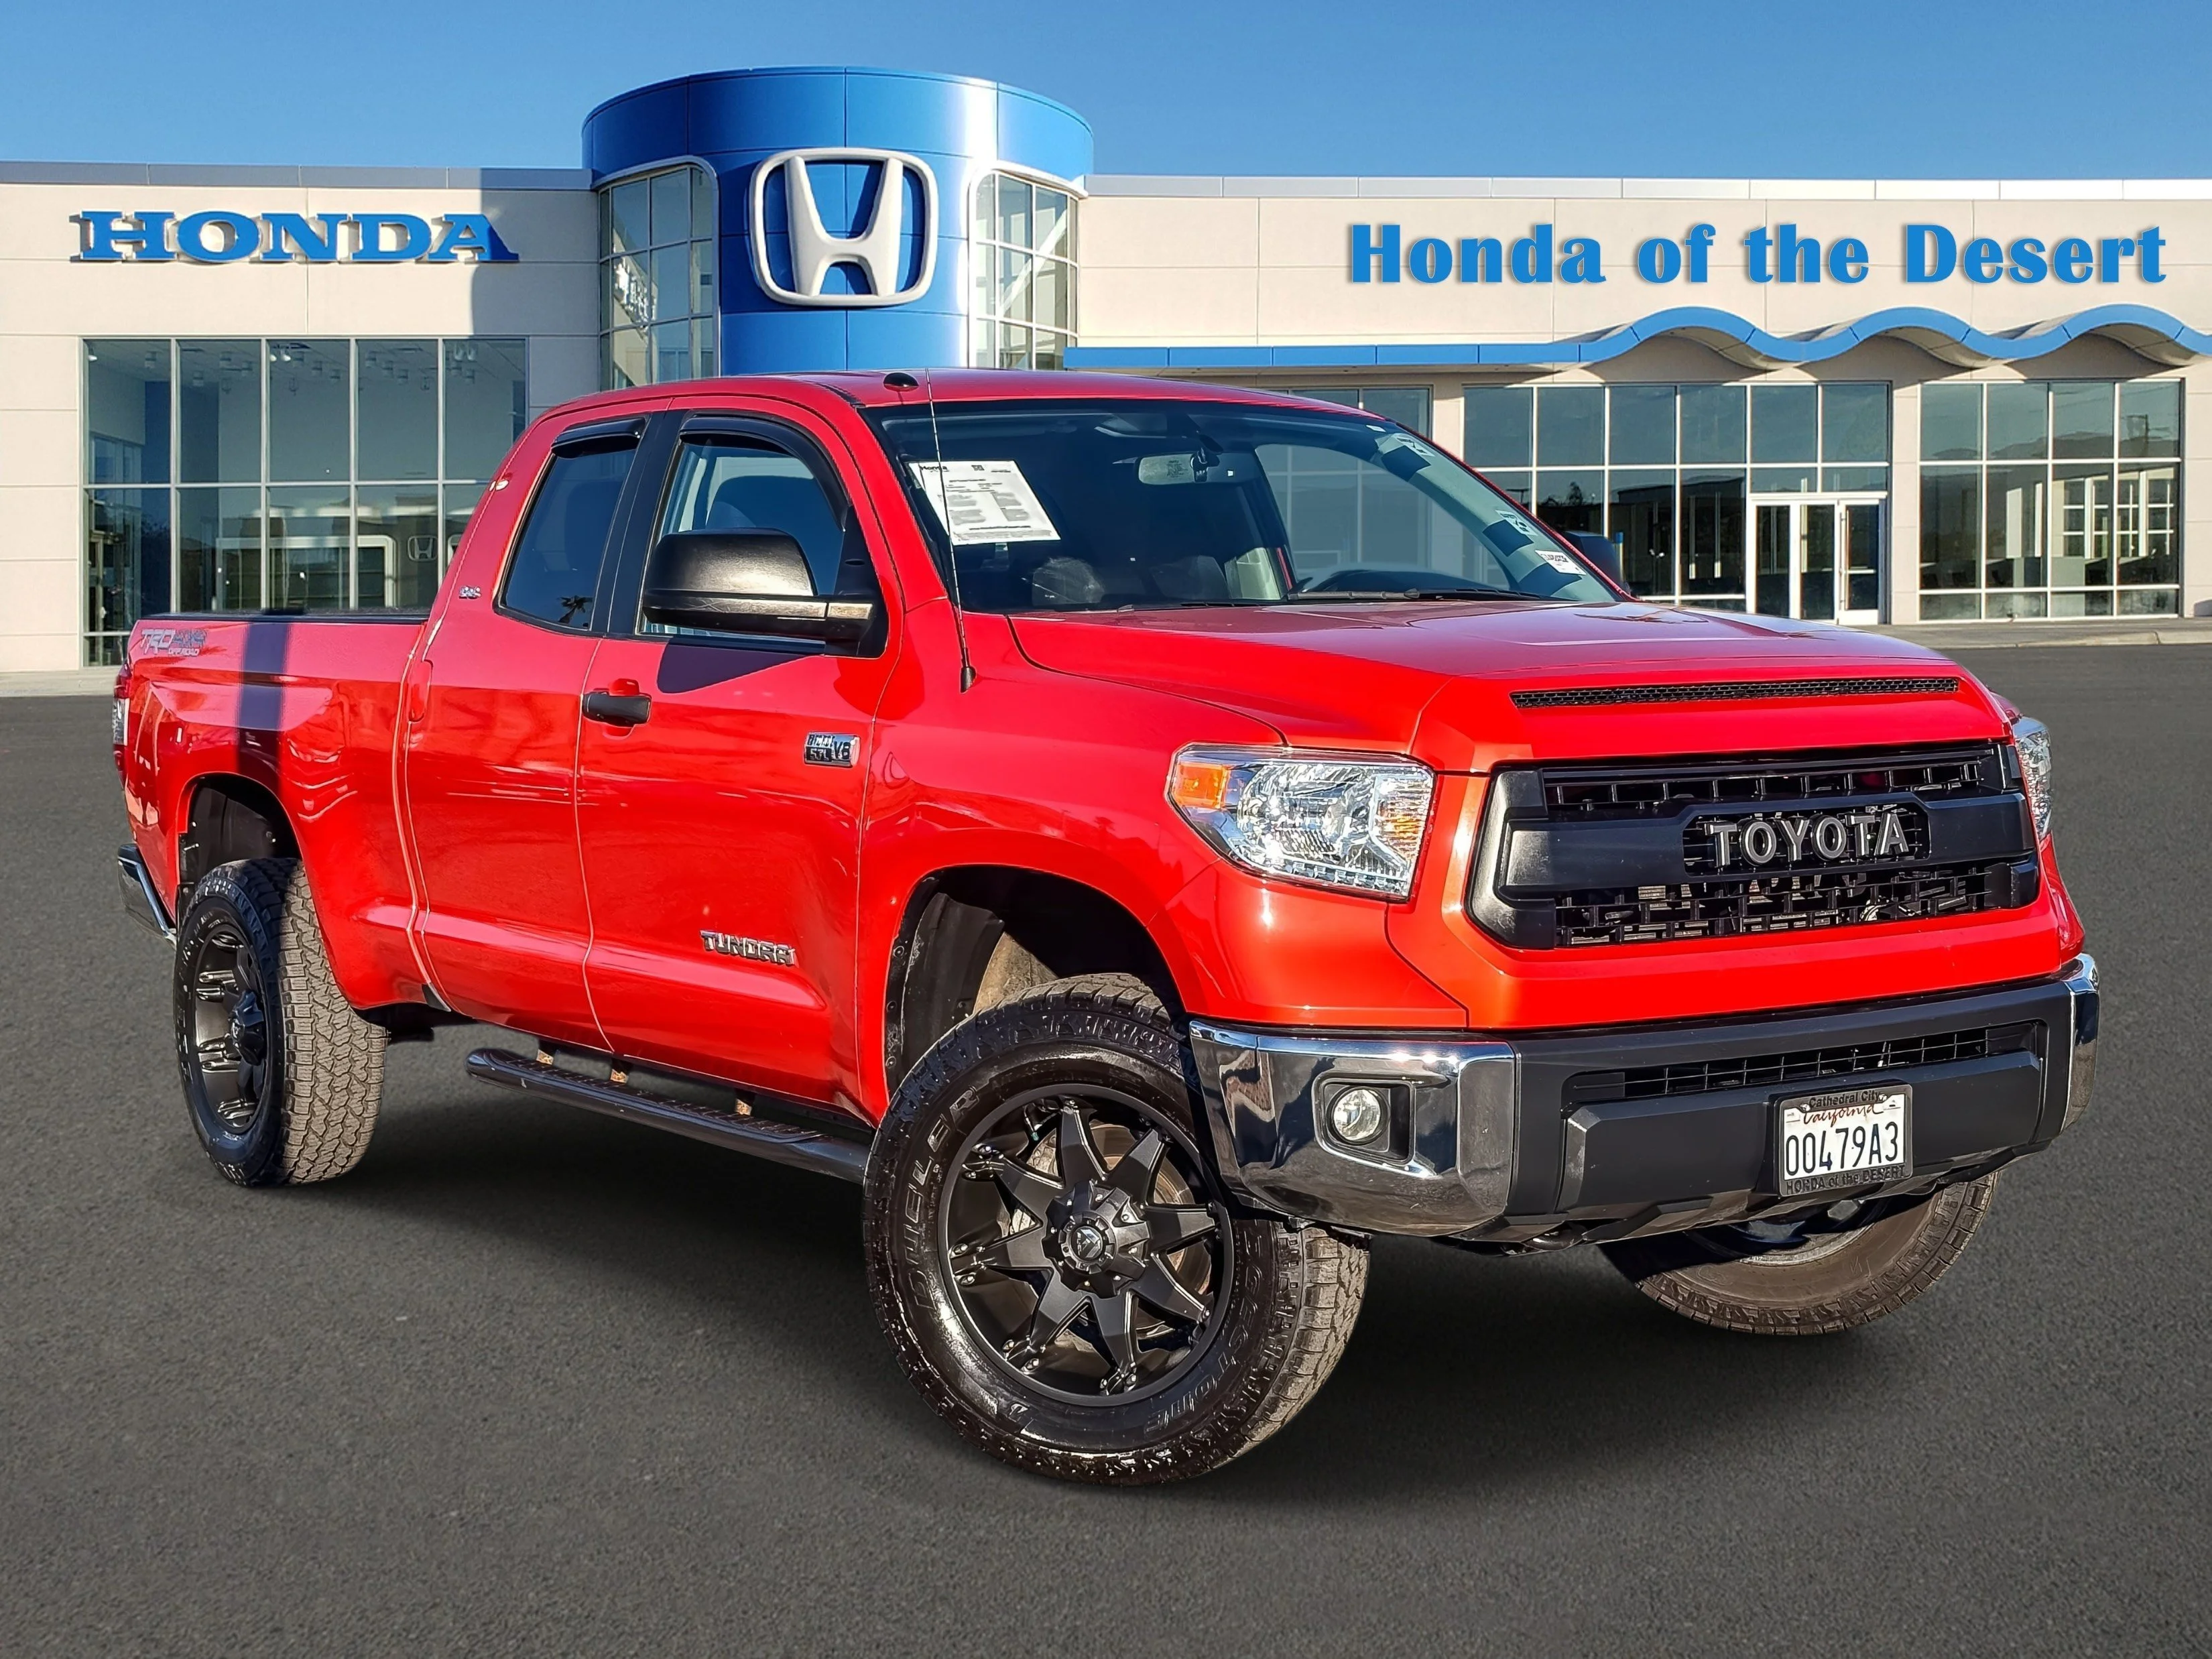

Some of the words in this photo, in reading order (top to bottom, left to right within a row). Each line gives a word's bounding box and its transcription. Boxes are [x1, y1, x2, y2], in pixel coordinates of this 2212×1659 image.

[80, 211, 519, 262] HONDA
[1351, 223, 1607, 284] Honda
[1637, 223, 1717, 284] of
[1743, 223, 1869, 284] the
[1906, 225, 2167, 284] Desert
[140, 629, 176, 654] TRD
[833, 741, 851, 760] V8
[1705, 812, 1909, 868] TOYOTA
[700, 930, 796, 966] TUNDRA
[1809, 1092, 1858, 1107] Cathedral
[1861, 1090, 1880, 1103] City
[1786, 1121, 1898, 1176] 00479A3
[1786, 1176, 1826, 1194] HONDA
[1828, 1175, 1839, 1188] of
[1842, 1172, 1860, 1186] the
[1861, 1165, 1905, 1182] DESERT
